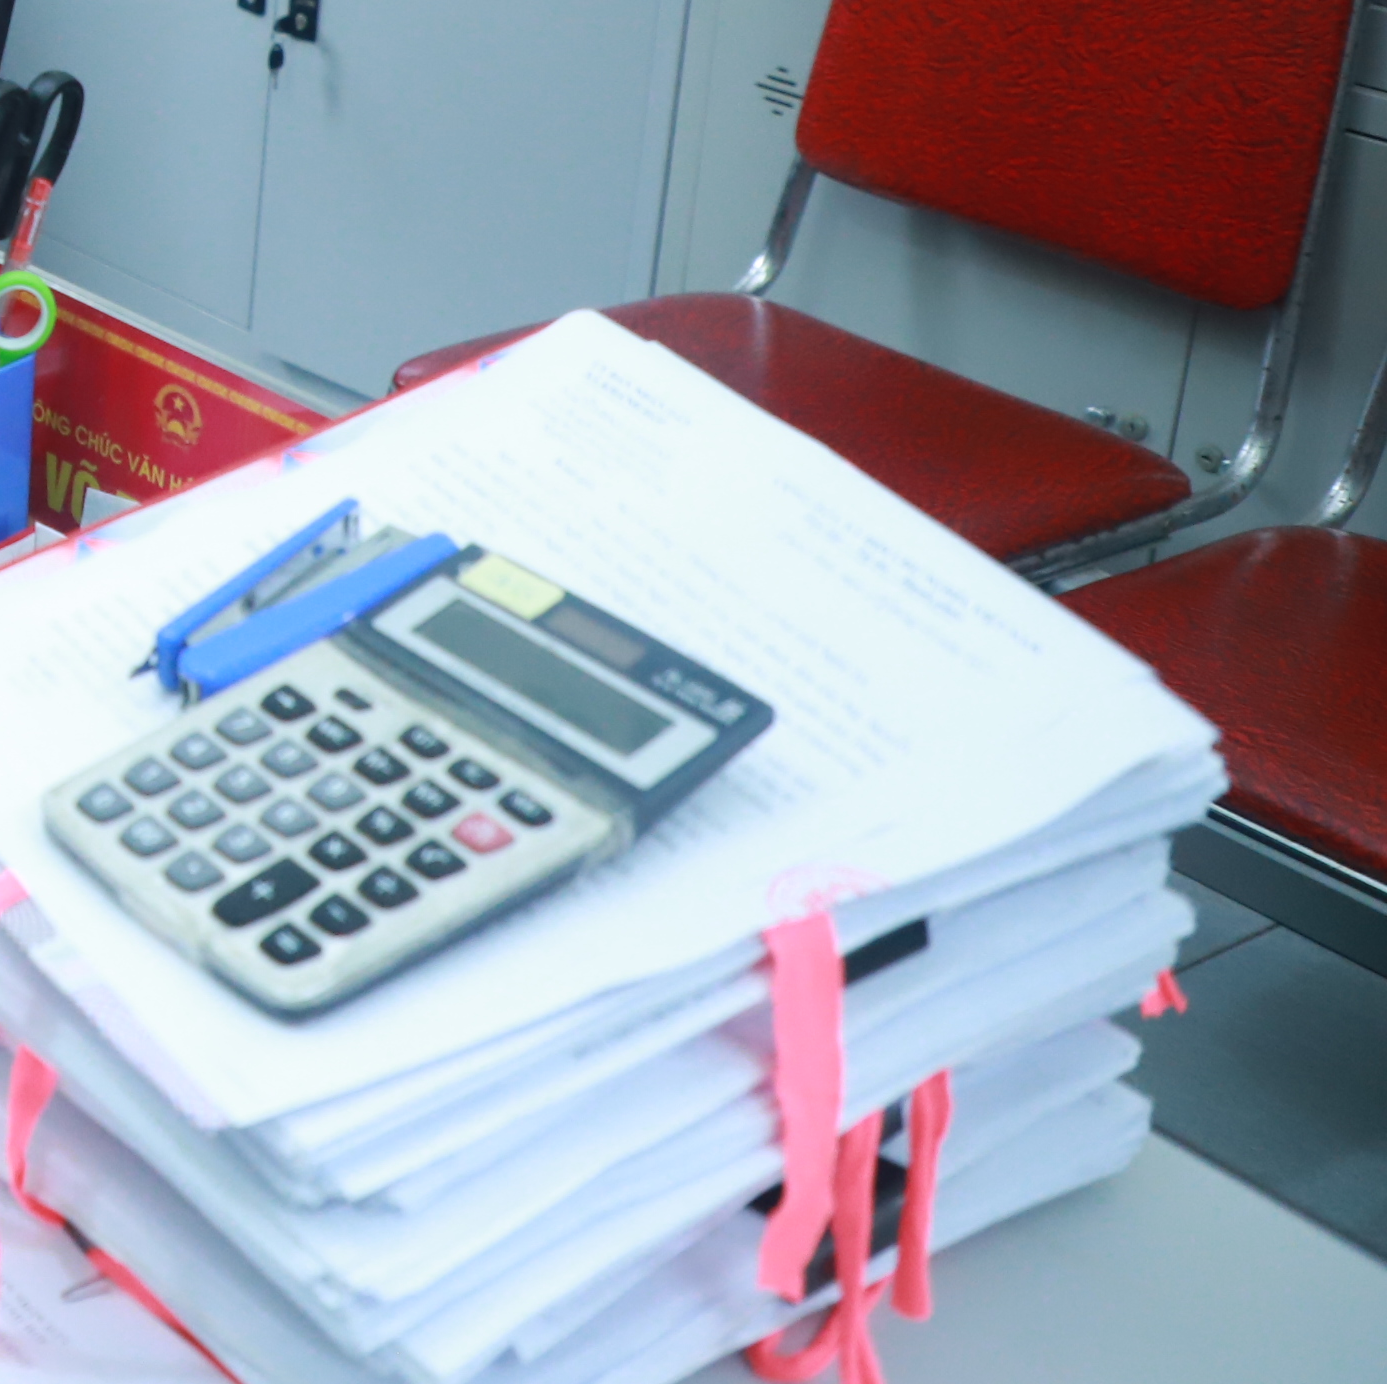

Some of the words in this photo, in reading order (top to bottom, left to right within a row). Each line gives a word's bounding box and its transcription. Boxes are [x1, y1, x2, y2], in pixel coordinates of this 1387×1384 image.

[33, 399, 71, 436] ÔNG
[74, 424, 123, 465] CHỨC
[127, 450, 166, 489] VĂN
